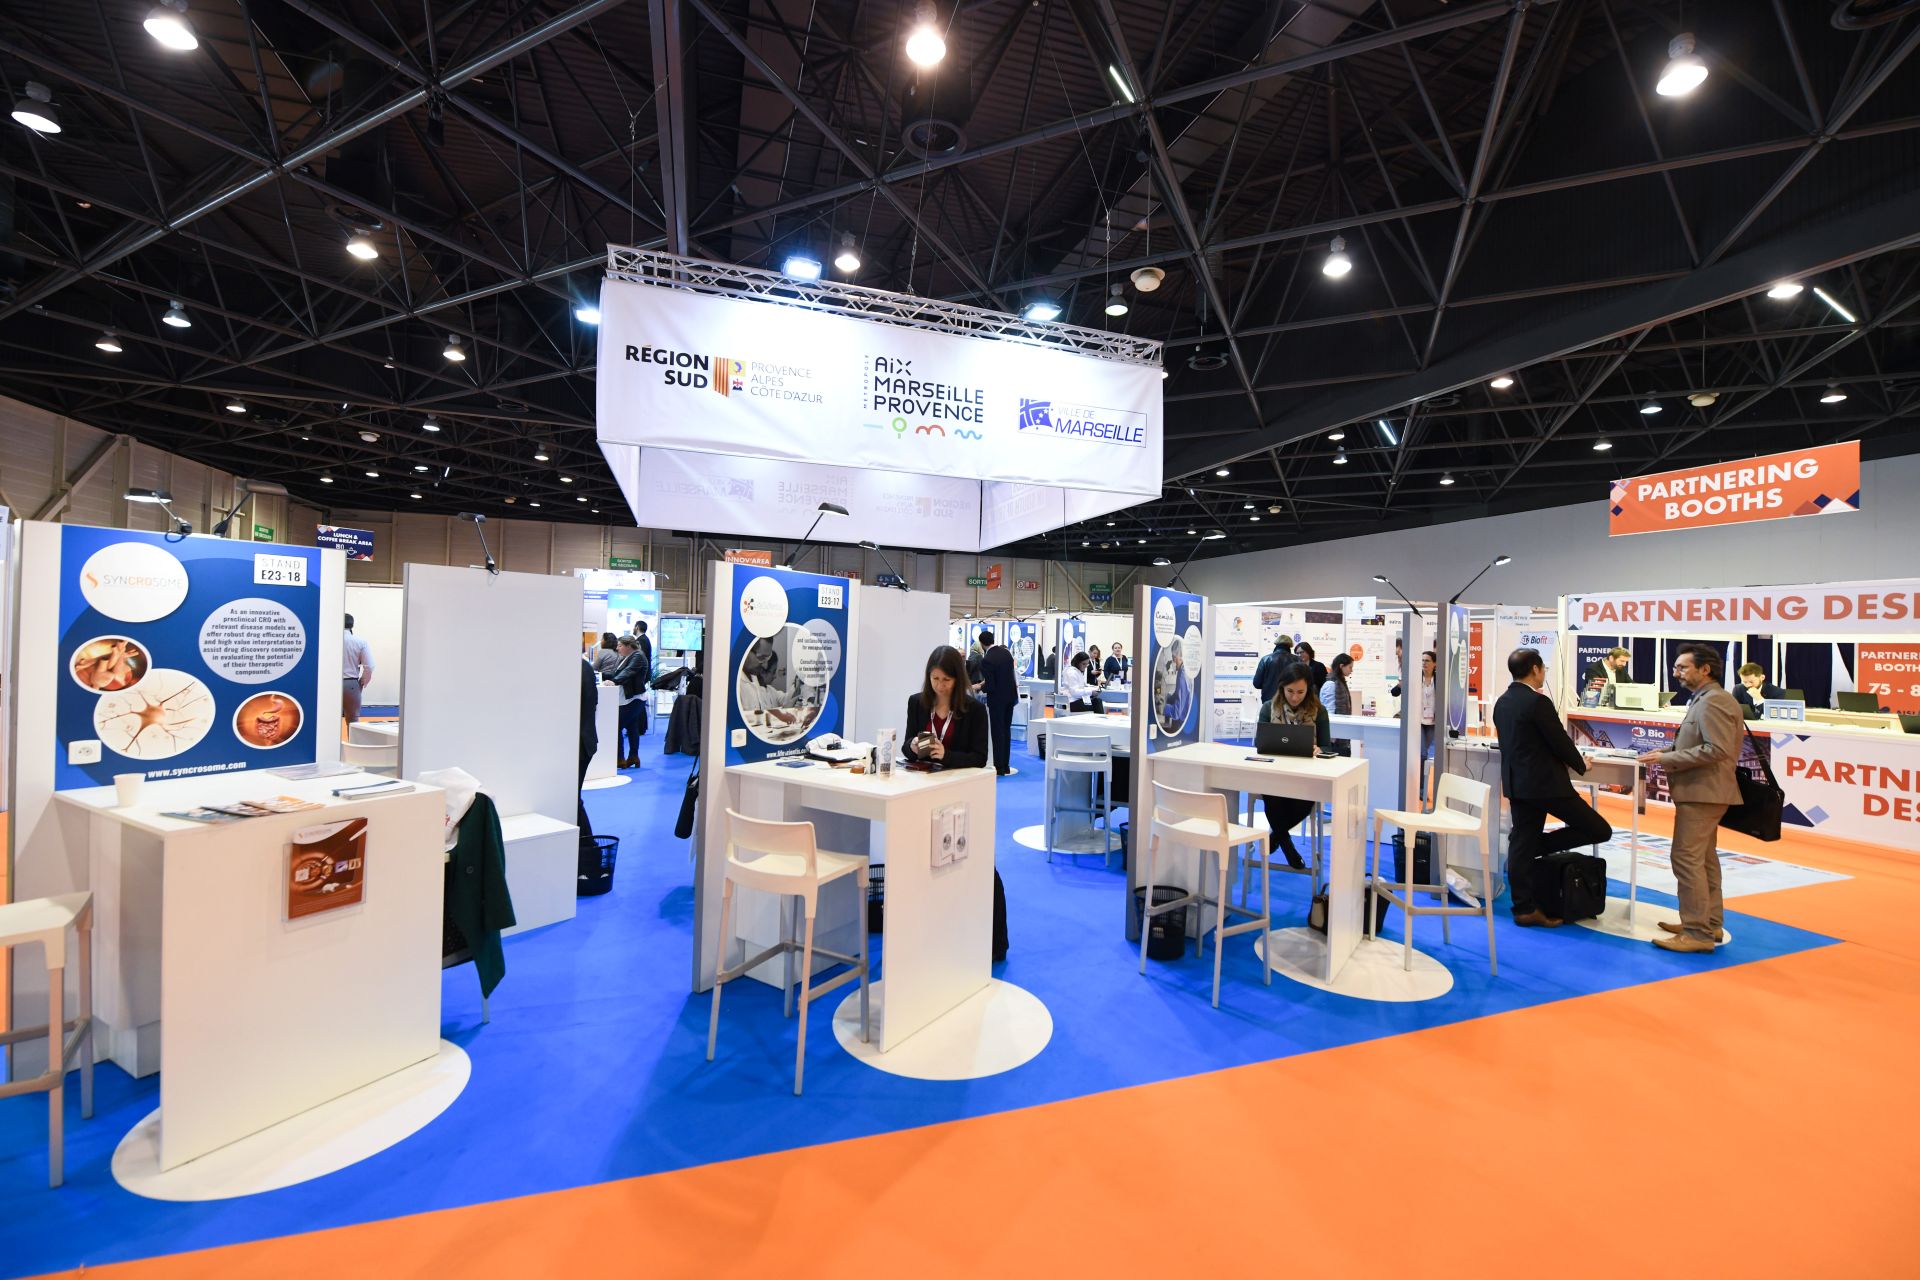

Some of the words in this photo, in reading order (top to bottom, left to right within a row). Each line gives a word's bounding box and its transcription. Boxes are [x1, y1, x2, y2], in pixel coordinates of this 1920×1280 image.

[625, 344, 709, 370] RÉGION
[751, 362, 811, 378] PROVENCE
[664, 370, 708, 389] SUD
[751, 374, 784, 387] ALPES
[751, 385, 781, 399] CÔTE
[784, 390, 823, 404] D'AZUR
[874, 395, 984, 423] PROVENCE
[1058, 407, 1080, 418] VILLE
[1083, 409, 1095, 420] DE
[1055, 418, 1144, 443] MARSEILLE
[1638, 458, 1818, 502] PARTNERING
[1665, 488, 1783, 520] BOOTHS
[333, 532, 353, 540] LUNCH
[261, 557, 301, 570] STAND
[725, 557, 770, 565] INNOV'AREA
[103, 574, 184, 590] SYNCROSOME
[261, 569, 301, 582] E23-18
[821, 587, 840, 596] STAND
[821, 596, 840, 606] E23-17
[1583, 595, 1809, 623] PARTNERING
[1823, 592, 1920, 621] DES
[1530, 635, 1548, 645] Biofit
[1868, 682, 1891, 695] 75
[148, 761, 247, 778] www.syncrosome.com
[1786, 756, 1920, 793] PARTN
